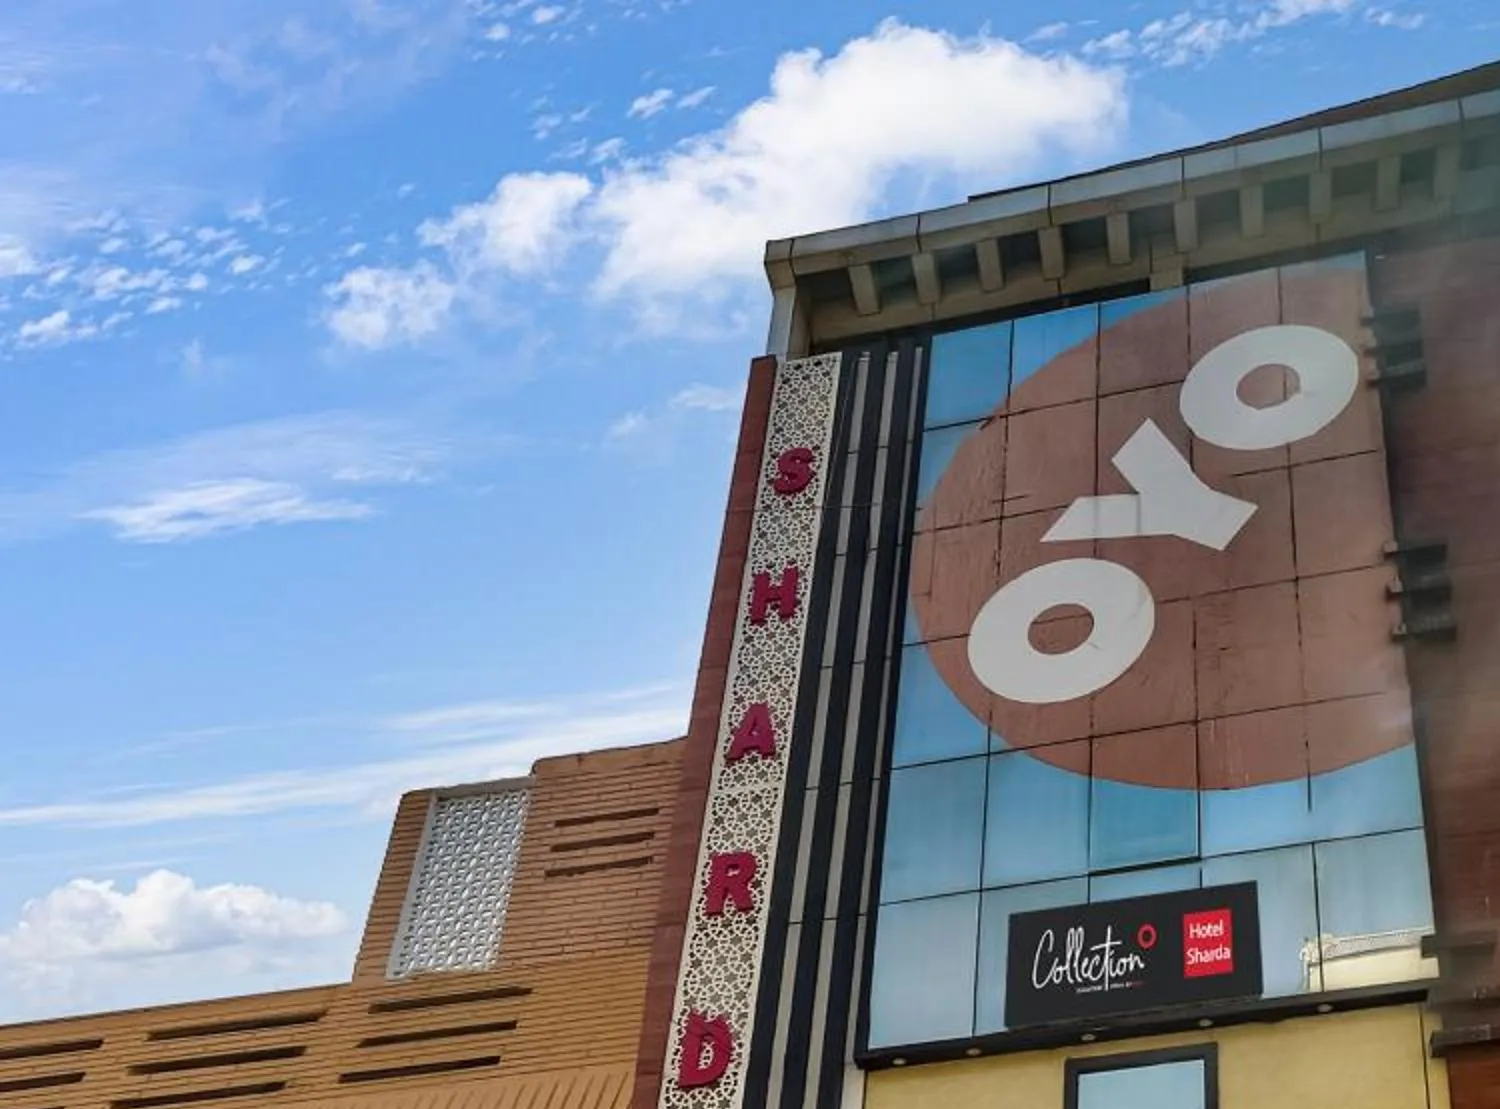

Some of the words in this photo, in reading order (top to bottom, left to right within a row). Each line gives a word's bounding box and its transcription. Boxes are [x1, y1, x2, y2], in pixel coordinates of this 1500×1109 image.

[967, 324, 1359, 703] OYO
[1189, 920, 1224, 938] Hotel
[1031, 925, 1145, 991] Collection
[1185, 944, 1231, 965] Sharda
